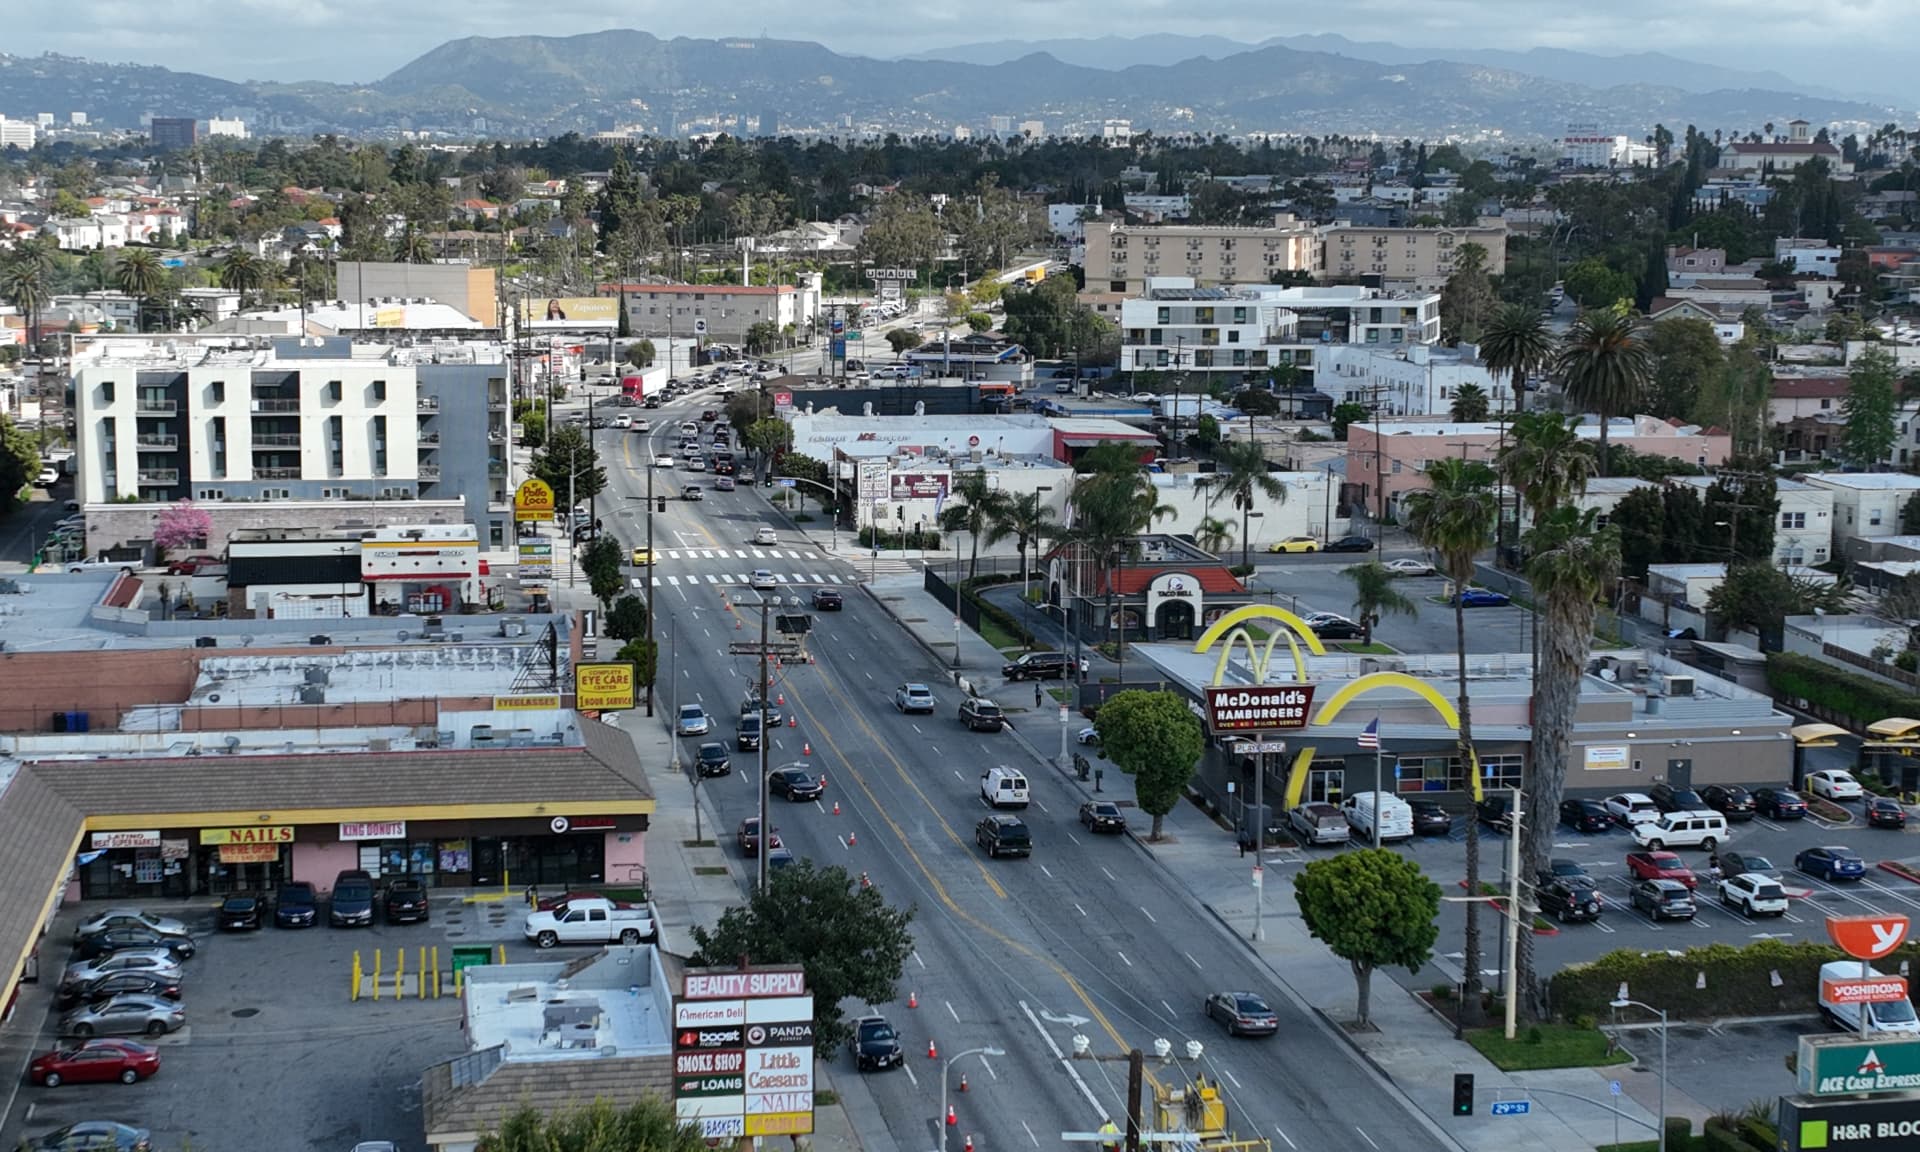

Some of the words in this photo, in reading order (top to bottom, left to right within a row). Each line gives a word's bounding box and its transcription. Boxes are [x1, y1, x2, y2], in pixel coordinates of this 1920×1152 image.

[523, 487, 547, 497] Pollo
[524, 496, 547, 506] Loco
[582, 676, 600, 685] EYE
[603, 675, 629, 685] CARE
[498, 697, 555, 706] EYEGLASSES
[585, 697, 603, 705] HOUR
[606, 697, 632, 705] SERVICE
[1215, 690, 1306, 707] McDonald's
[1217, 708, 1303, 720] HAMBURGERS
[229, 828, 292, 842] NAILS
[343, 823, 364, 836] KING
[367, 822, 402, 836] DONUTS
[687, 975, 746, 996] BEAUTY
[749, 973, 803, 993] SUPPLY
[680, 1008, 724, 1020] American
[727, 1008, 743, 1018] Deli
[700, 1030, 739, 1042] boost
[770, 1026, 812, 1037] PANDA
[677, 1054, 713, 1073] SMOKE
[715, 1053, 742, 1071] SHOP
[760, 1052, 801, 1069] Little
[702, 1078, 742, 1090] LOANS
[748, 1071, 808, 1089] Caesars
[1819, 1077, 1845, 1092] ACE
[761, 1093, 810, 1112] NAILS
[706, 1119, 741, 1135] BASKETS
[1832, 1123, 1872, 1141] H&R
